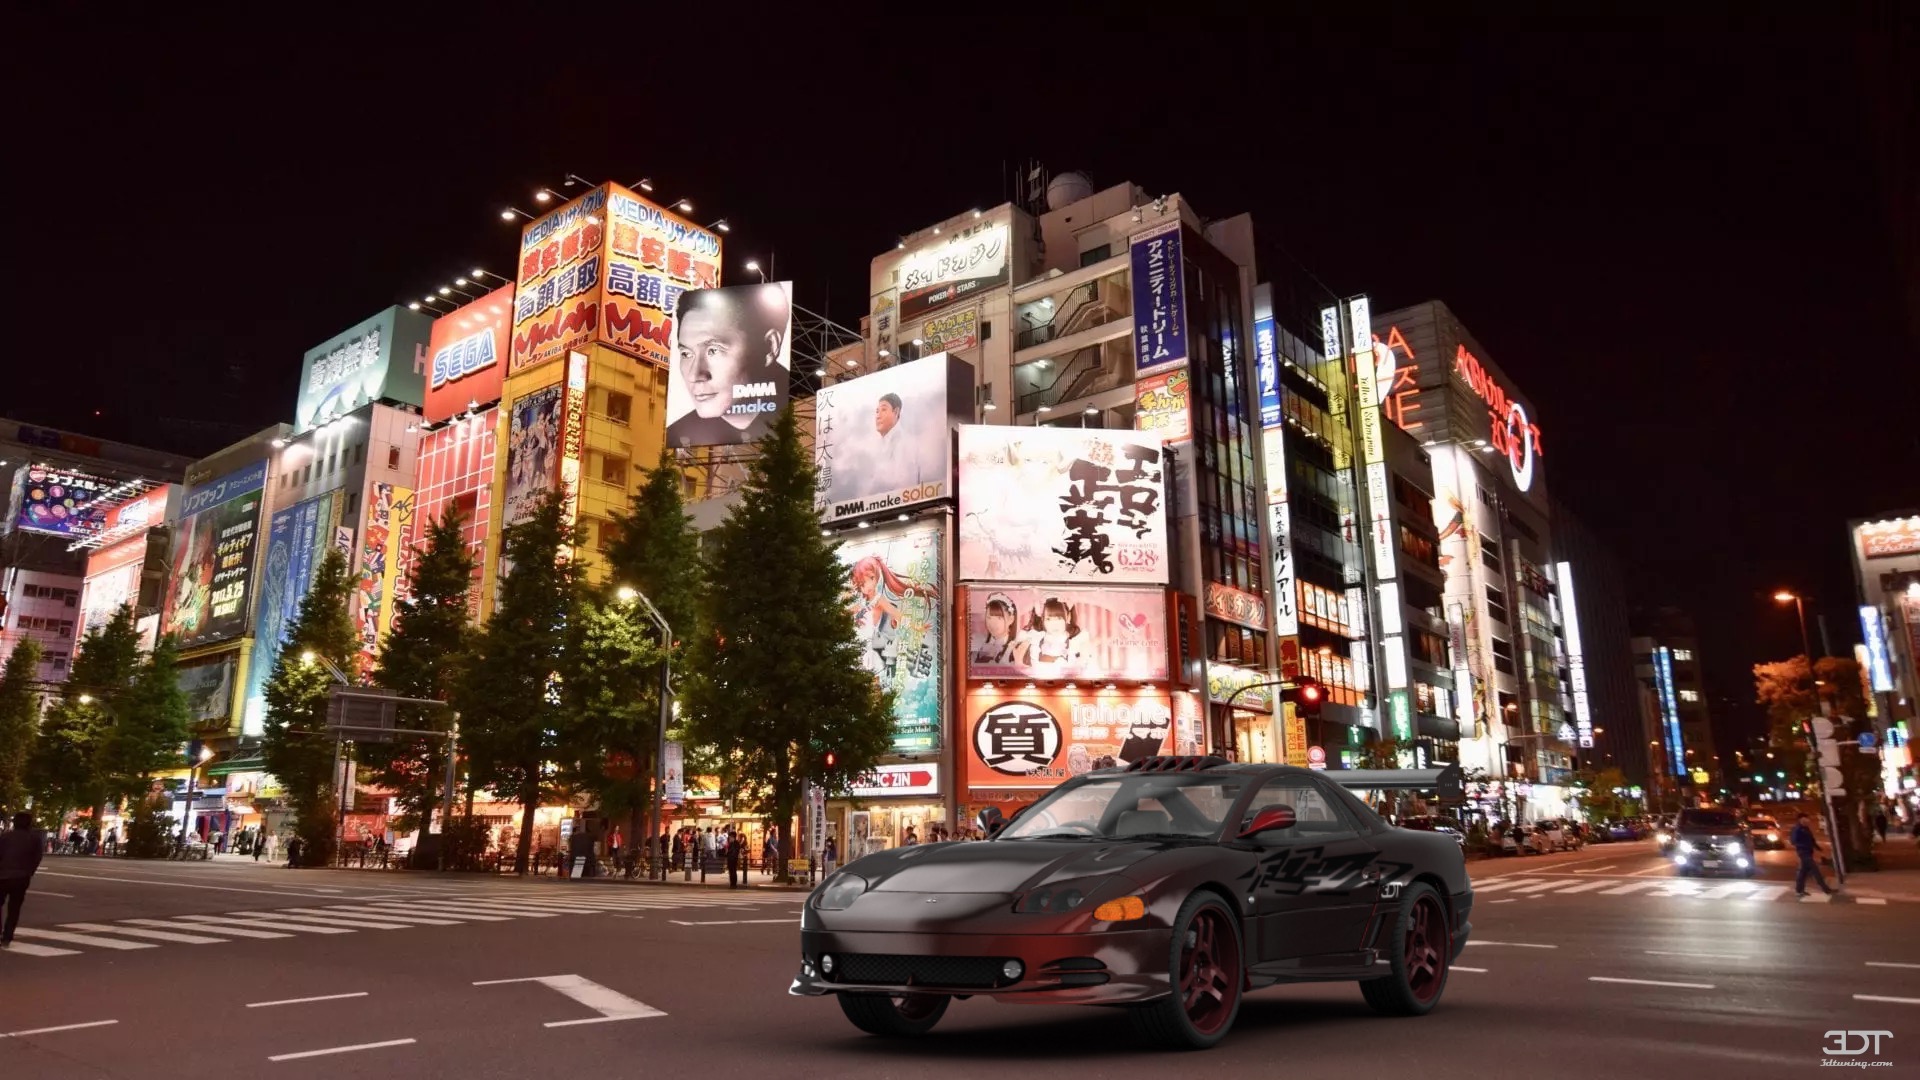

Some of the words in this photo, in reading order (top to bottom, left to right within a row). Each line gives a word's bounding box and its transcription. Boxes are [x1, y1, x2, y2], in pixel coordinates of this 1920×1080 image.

[1147, 239, 1170, 360] アメニティードリーム
[433, 330, 494, 386] SEGA
[733, 381, 776, 399] DMM
[184, 480, 227, 512] ソフマップ
[902, 481, 943, 503] solar
[1117, 549, 1156, 567] 6.28
[1274, 505, 1292, 618] 喫茶室ルノアール
[985, 712, 1052, 767] 質
[892, 771, 911, 787] ZIN
